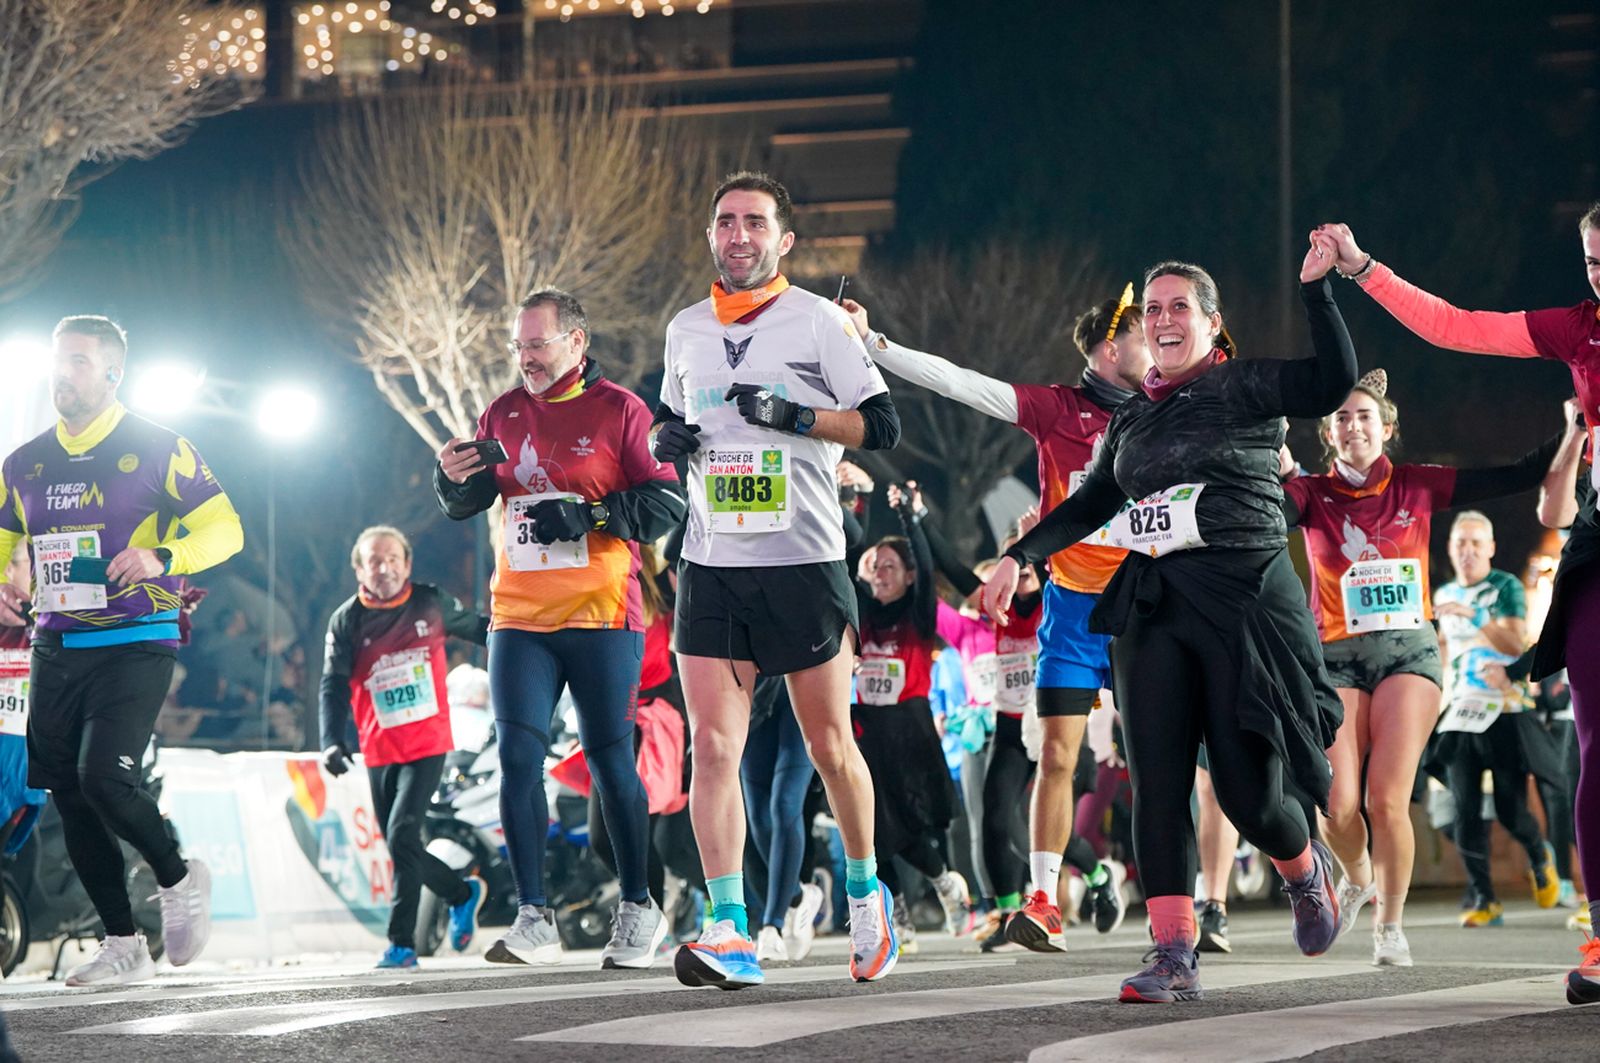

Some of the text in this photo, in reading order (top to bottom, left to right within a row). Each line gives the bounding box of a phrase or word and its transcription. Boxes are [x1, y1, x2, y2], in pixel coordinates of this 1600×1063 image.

[717, 454, 754, 464] NOCHE DE
[709, 465, 723, 475] SAN
[55, 482, 87, 495] FUEGO
[528, 473, 547, 494] 43
[715, 476, 773, 503] 8483
[46, 495, 80, 510] TEAM
[1129, 504, 1171, 536] 825
[1162, 533, 1173, 541] EVA
[1359, 569, 1381, 577] NOCHE
[1351, 579, 1366, 587] SAN
[1360, 584, 1409, 608] 8150
[384, 683, 423, 707] 9291
[353, 807, 384, 851] SA
